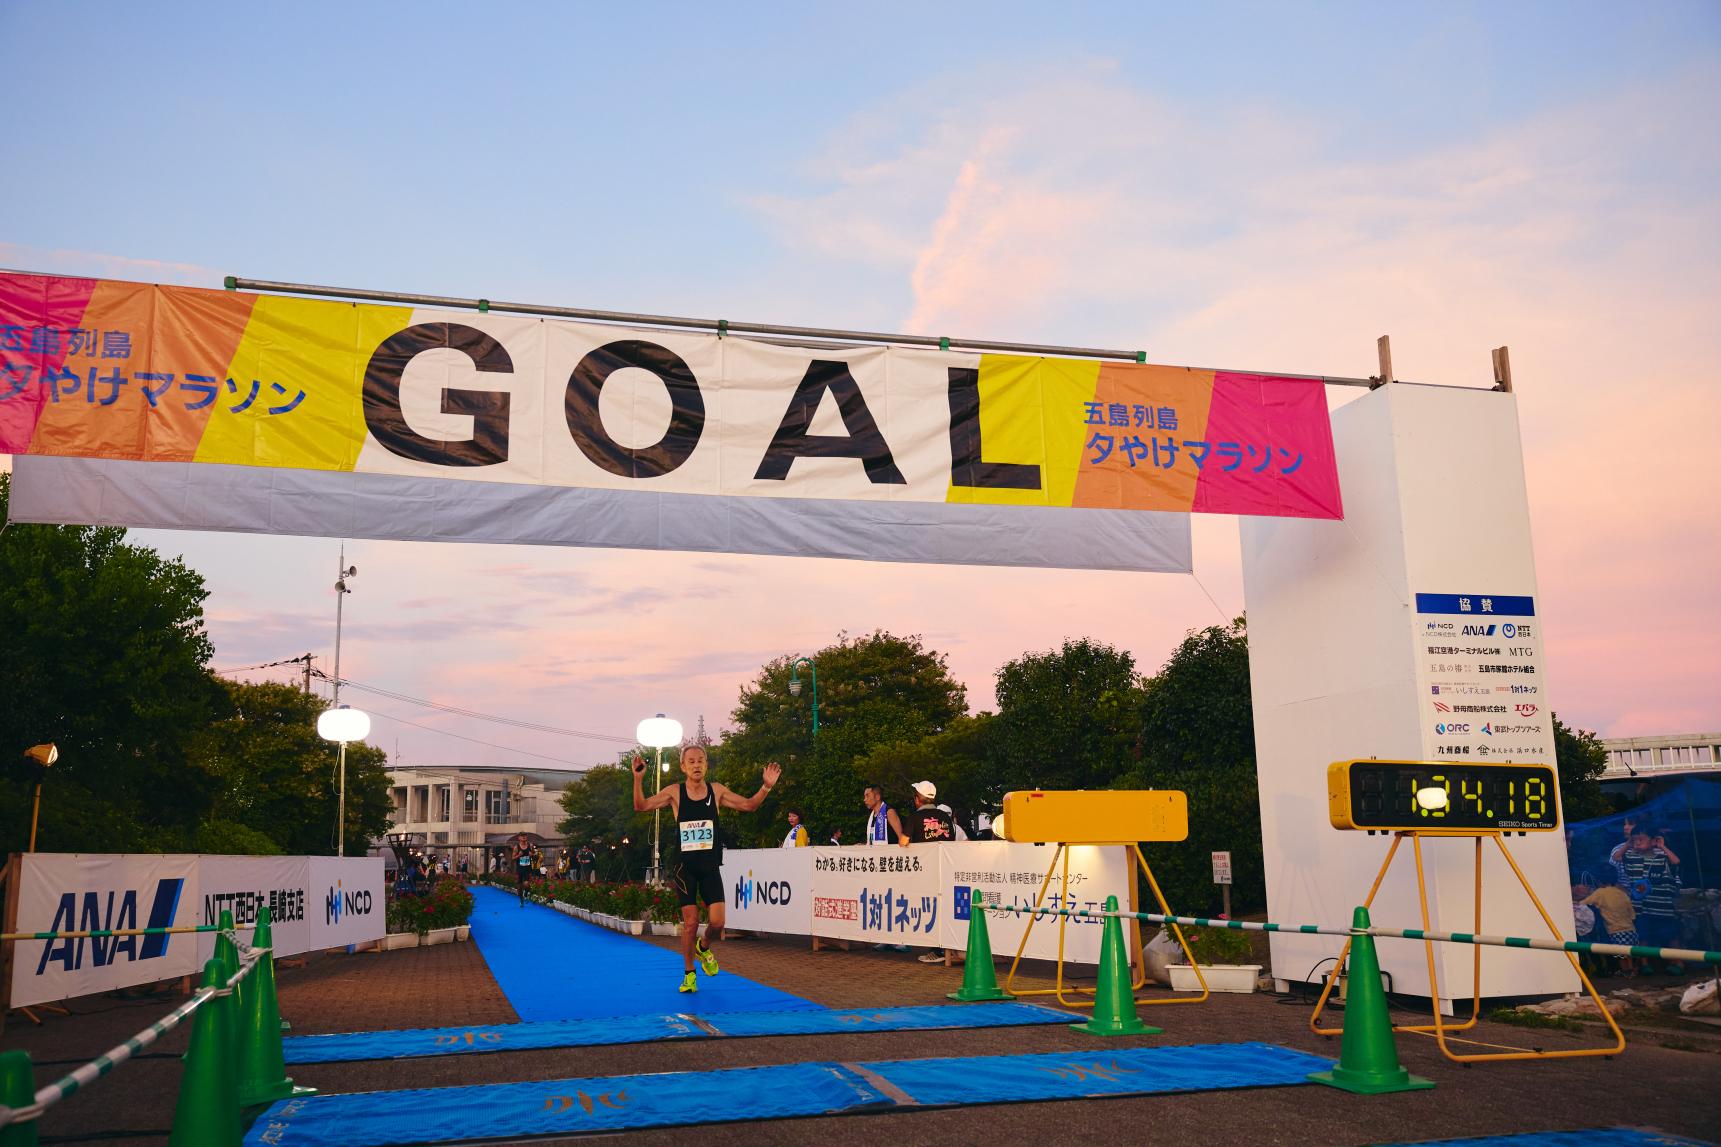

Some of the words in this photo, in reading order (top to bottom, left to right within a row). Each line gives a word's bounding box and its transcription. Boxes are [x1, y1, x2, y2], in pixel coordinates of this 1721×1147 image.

[0, 324, 132, 358] 五島列島
[0, 361, 306, 415] 夕やけマラソン
[362, 321, 1041, 490] GOAL
[1084, 401, 1178, 431] 五島列島
[1086, 432, 1303, 475] 夕やけマラソン
[1461, 625, 1485, 636] ANA
[1509, 647, 1533, 657] MTG
[1447, 724, 1470, 732] ORC
[682, 828, 712, 841] 3123
[756, 880, 792, 906] NCD
[1009, 872, 1088, 885] 精神医療サートンター
[270, 888, 304, 923] 長崎支店
[345, 890, 372, 917] NCD
[860, 888, 938, 933] 1対1ネッツ
[36, 890, 136, 975] ANA
